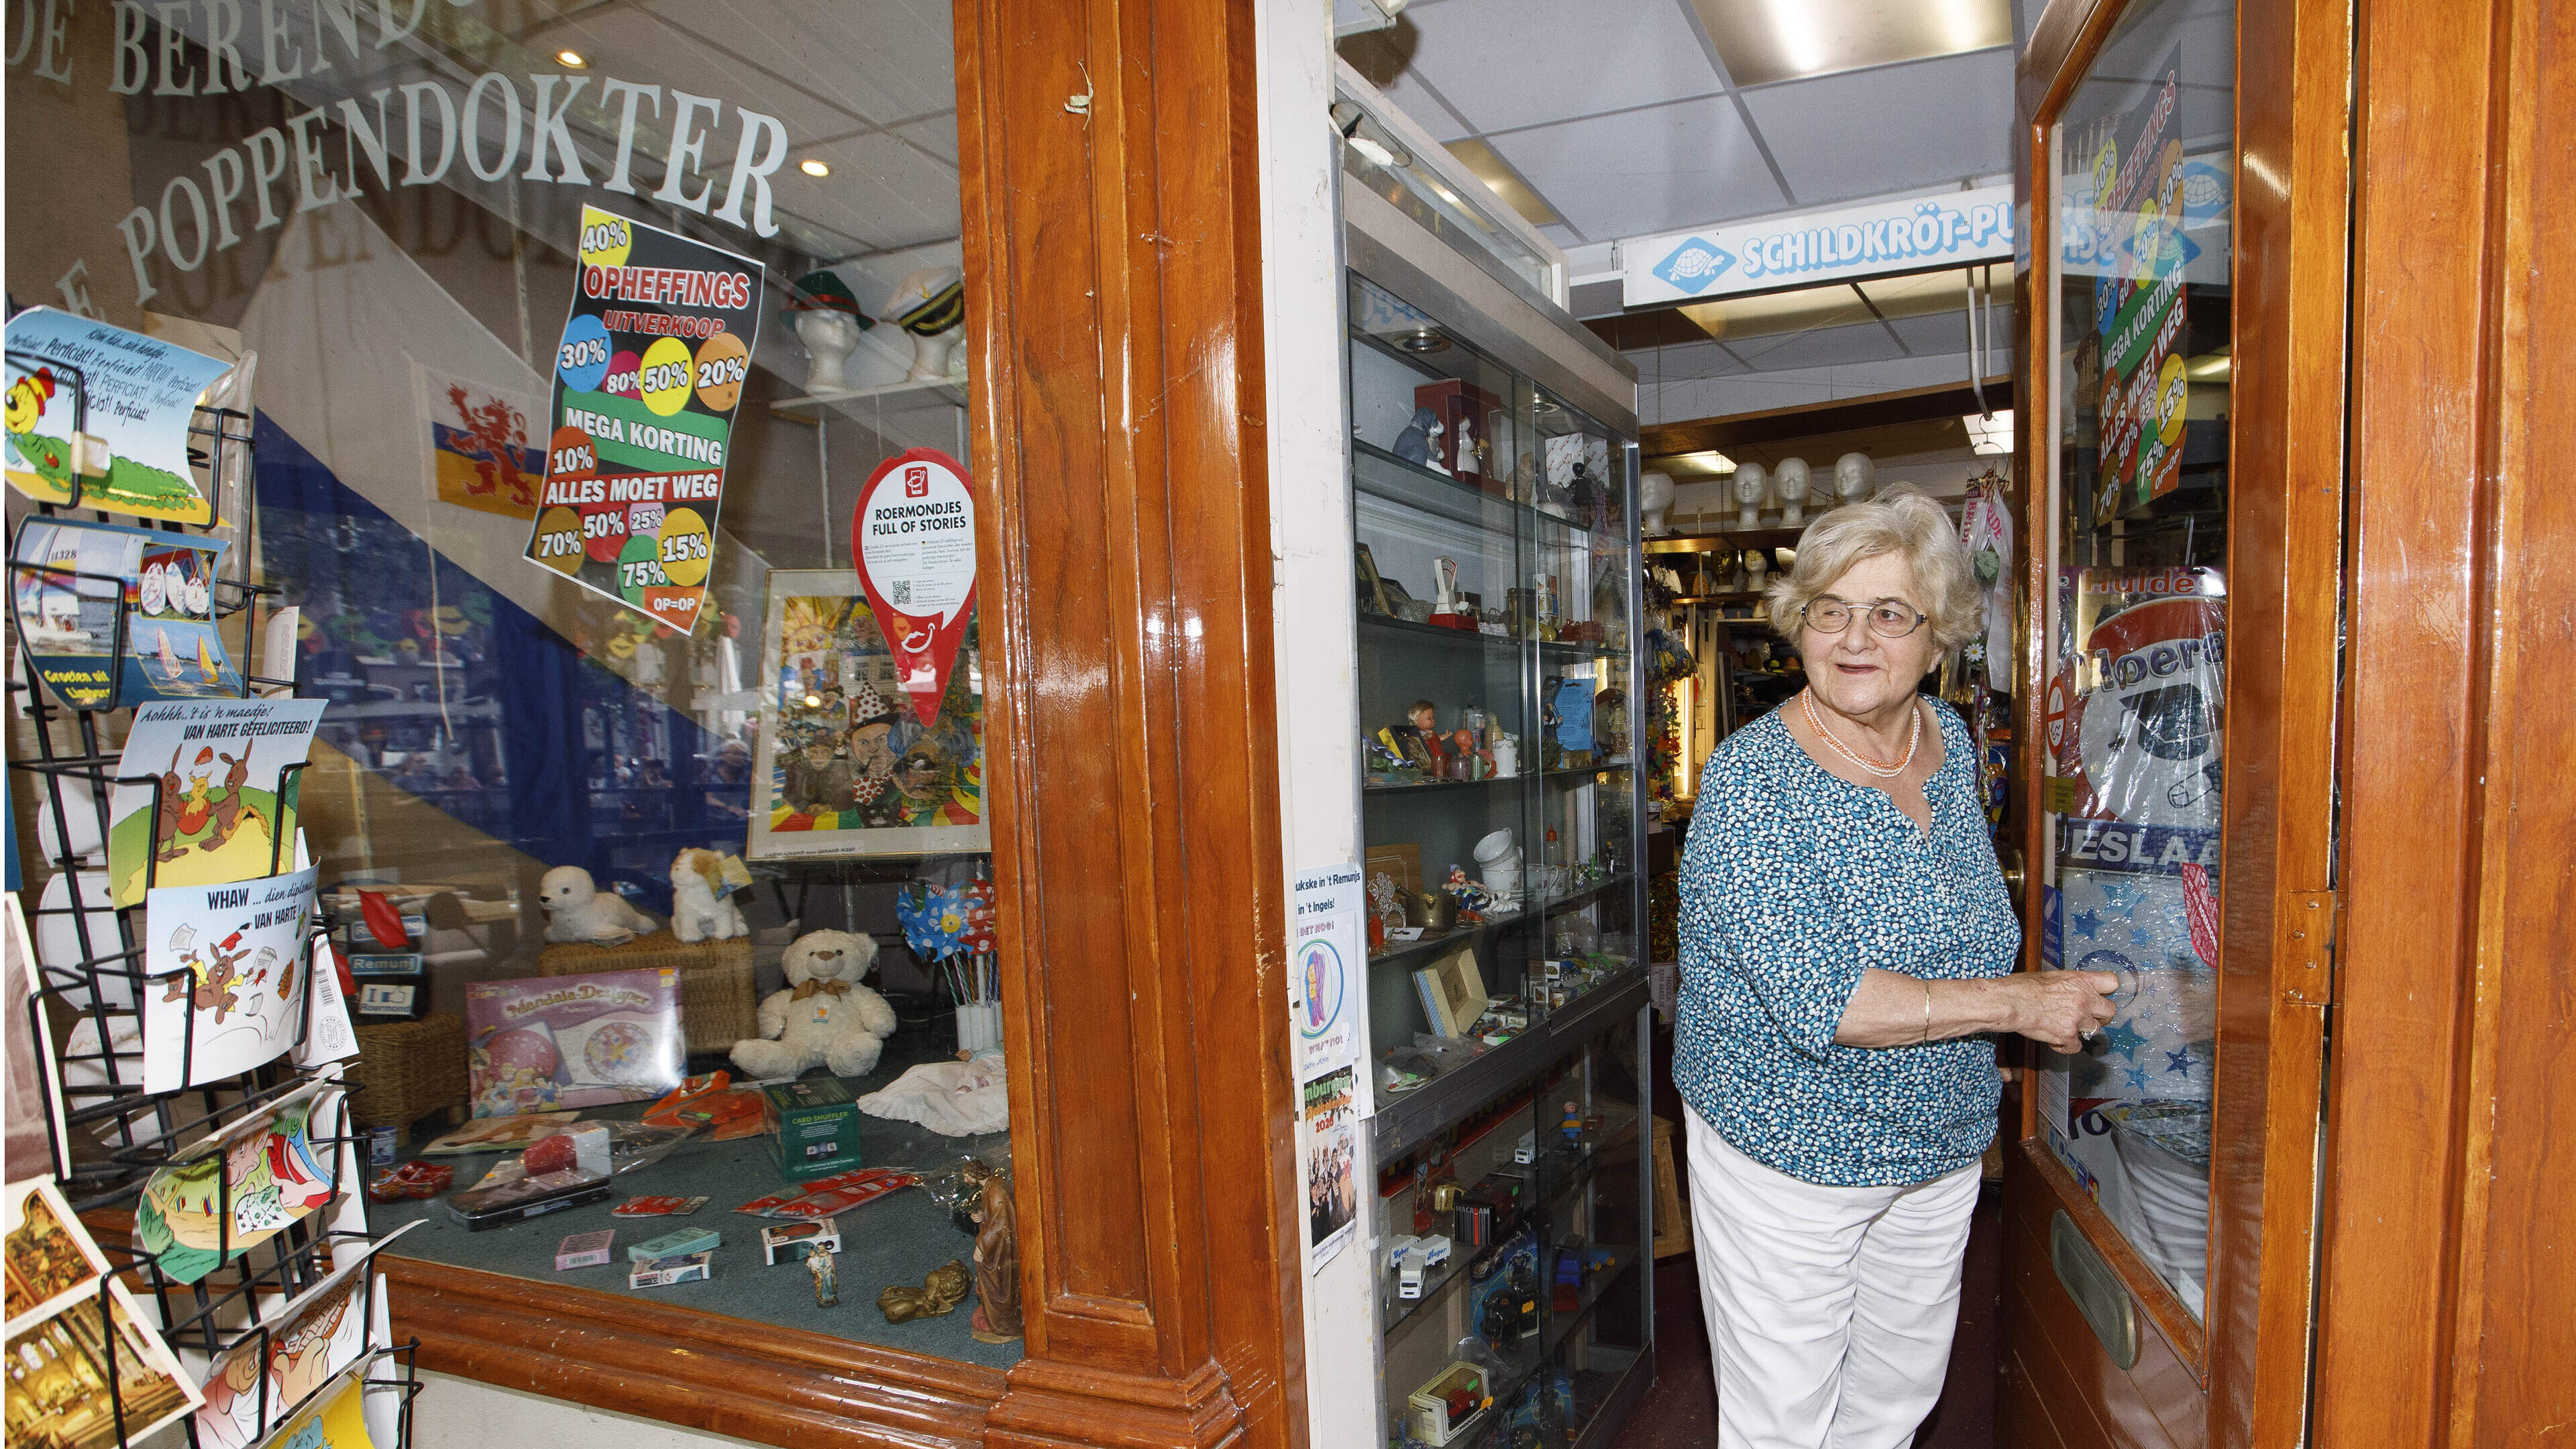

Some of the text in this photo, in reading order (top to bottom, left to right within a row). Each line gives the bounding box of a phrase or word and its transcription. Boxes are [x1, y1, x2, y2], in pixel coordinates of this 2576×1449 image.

[115, 72, 780, 305] POPPENDOKTER
[2094, 144, 2114, 203] 40%
[2159, 150, 2182, 226] 20%
[582, 219, 628, 254] 40%
[2135, 209, 2157, 276] 50%
[584, 264, 751, 310] OPHEFFINGS
[2097, 264, 2117, 323] 30%
[602, 309, 726, 339] UITVERKOOP
[2104, 260, 2182, 374] MEGA KORTING
[560, 337, 606, 370] 30%
[101, 374, 150, 400] PERFICIAT!
[606, 370, 641, 394] 80%
[643, 360, 688, 394] 50%
[697, 354, 745, 389] 20%
[2100, 297, 2184, 466] ALLES MOET WEG
[114, 398, 150, 426] Perficiat!
[2100, 378, 2118, 432] 10%
[2139, 386, 2158, 427] 25%
[2159, 370, 2185, 433] 15%
[566, 407, 722, 467] MEGA KORTING
[2118, 418, 2139, 470] 50%
[553, 444, 594, 474] 10%
[2139, 437, 2163, 490] 75%
[2155, 447, 2180, 491] OP=OP
[545, 472, 718, 504] ALLES MOET WEG
[2099, 472, 2120, 519] 70%
[583, 510, 625, 539] 50%
[631, 508, 663, 531] 25%
[873, 516, 966, 536] FULL OF STORIES
[875, 500, 962, 521] ROERMONDJES
[1962, 500, 1978, 548] BRIDE
[540, 529, 582, 557] 70%
[662, 532, 708, 564] 15%
[622, 558, 666, 588] 75%
[2084, 569, 2215, 594] Hulde
[653, 596, 696, 612] OP=OP
[183, 720, 313, 741] VAN HARTE GEFELICITEERD!
[200, 706, 209, 720] is
[225, 706, 273, 724] maedje!
[1319, 877, 1326, 888] in
[1326, 875, 1332, 886] 't
[1333, 870, 1360, 885] Remunjs
[207, 888, 249, 910] WHAW
[264, 888, 287, 903] dien
[1298, 904, 1304, 915] in
[1313, 898, 1335, 912] Ingels!
[255, 912, 272, 929] VAN
[274, 908, 296, 924] HARTE
[354, 958, 414, 971] Remunj
[506, 991, 577, 1017] Mandala
[792, 1116, 812, 1125] CARD
[813, 1111, 849, 1122] SHUFFLER
[1316, 1114, 1334, 1133] 2026
